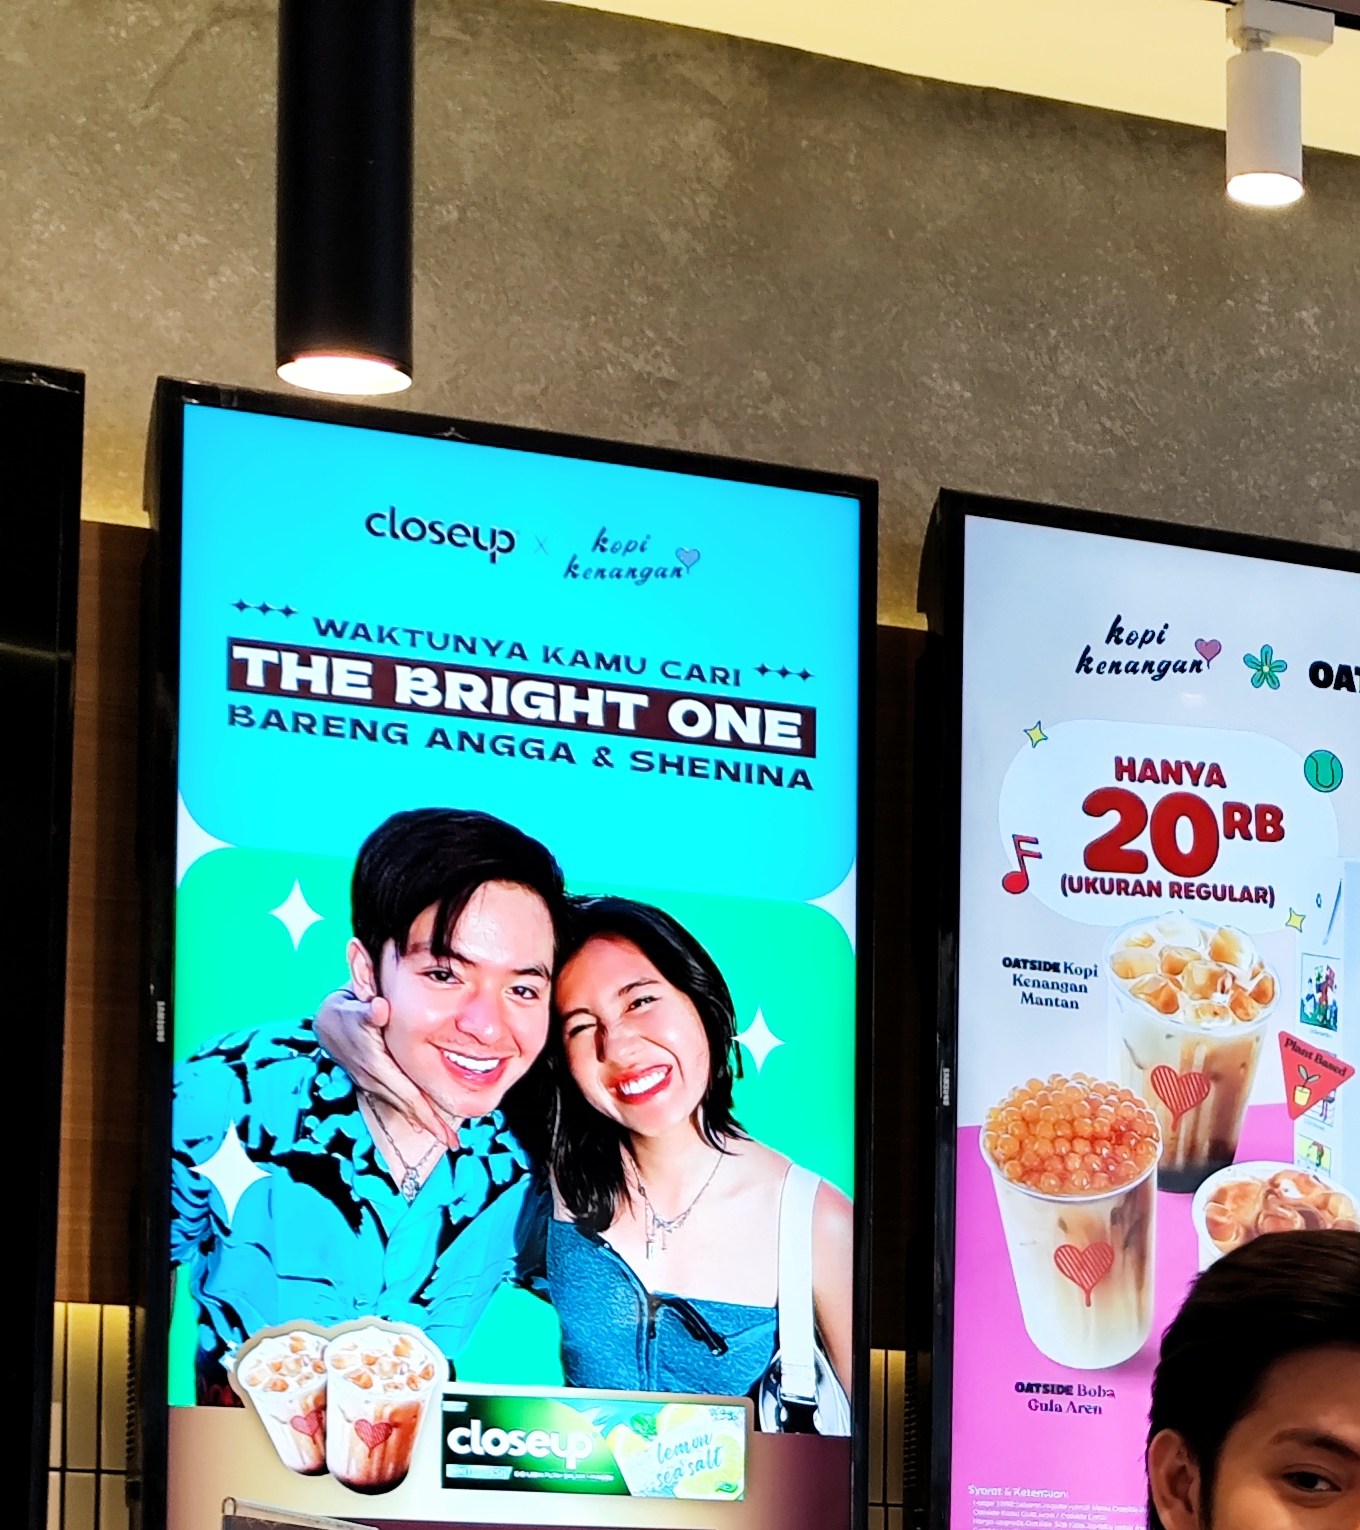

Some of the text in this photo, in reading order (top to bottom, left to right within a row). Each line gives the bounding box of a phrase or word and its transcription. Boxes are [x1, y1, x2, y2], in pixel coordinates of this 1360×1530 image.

[365, 505, 516, 564] closeup
[591, 526, 651, 557] kopi
[563, 553, 684, 586] kenangan
[1105, 613, 1169, 648] kopi
[313, 616, 741, 687] WAKTUNYA KAMU CARI
[1075, 644, 1203, 681] kenangan
[232, 645, 802, 750] THE BRIGHT ONE
[228, 703, 814, 791] BARENG ANGGA & SHENINA
[1114, 755, 1227, 789] HANYA
[1060, 873, 1275, 909] (UKURAN REGULAR)
[1002, 956, 1099, 980] OATSIDE Kopi
[1012, 973, 1088, 994] Kenangan
[1020, 991, 1080, 1010] Mantan
[1283, 1036, 1347, 1077] Plant Based
[1014, 1381, 1116, 1400] OATSIDE Boba
[1027, 1397, 1103, 1415] Gula Aren
[446, 1418, 594, 1470] closeup
[656, 1432, 713, 1464] lemon
[655, 1444, 725, 1488] sea salt
